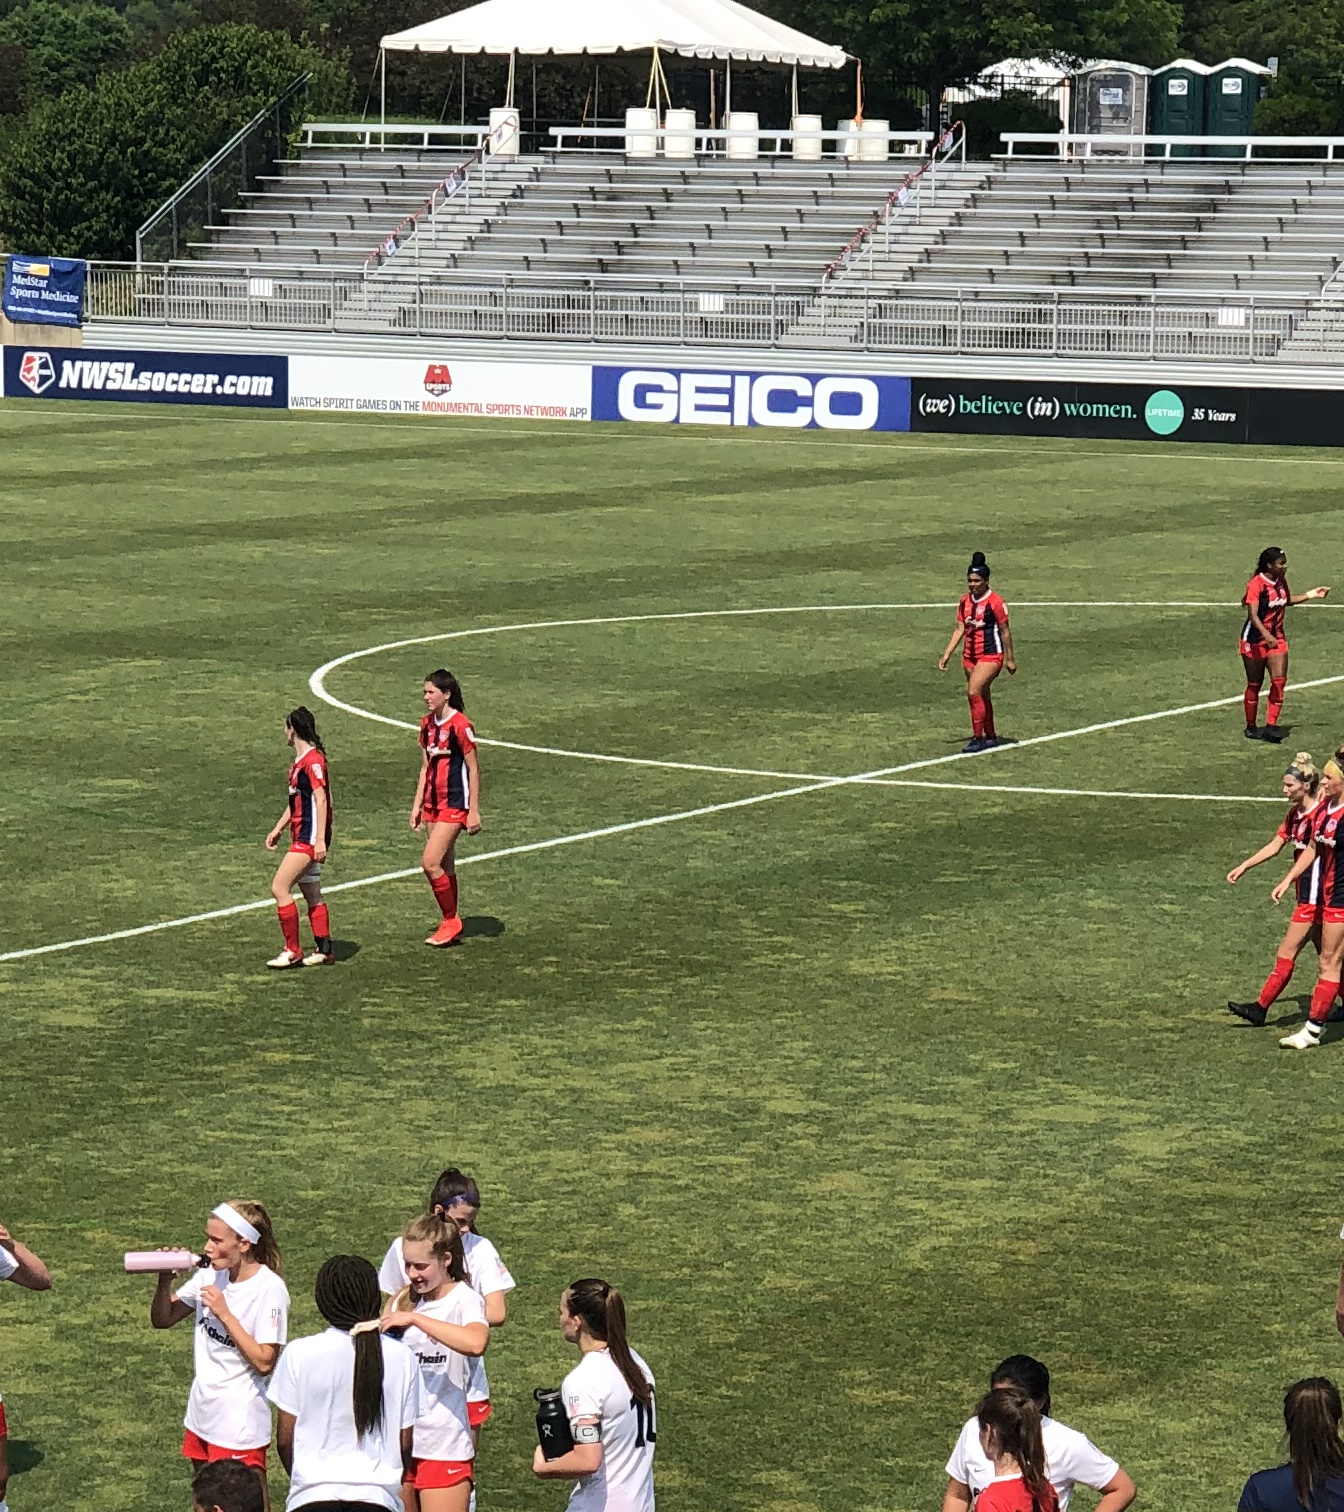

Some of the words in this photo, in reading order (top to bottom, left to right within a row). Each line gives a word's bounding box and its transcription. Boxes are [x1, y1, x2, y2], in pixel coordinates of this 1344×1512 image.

[12, 275, 48, 288] MedStar
[10, 286, 39, 299] Sports
[41, 290, 79, 303] Medicine
[59, 360, 273, 396] NWSLsoccer.com
[291, 396, 321, 408] WATCH
[323, 398, 354, 409] SPIRIT
[356, 399, 387, 411] GAMES
[389, 400, 402, 411] ON
[404, 401, 420, 412] THE
[422, 401, 484, 414] MONUMENTAL
[486, 404, 521, 415] SPORTS
[523, 405, 567, 417] NETWORK
[569, 407, 587, 418] APP
[617, 370, 879, 430] GEICO
[918, 393, 955, 416] (we)
[959, 394, 1023, 416] believe
[1027, 396, 1060, 419] (in)
[1064, 402, 1137, 419] women.
[1192, 408, 1205, 420] 35
[1208, 409, 1236, 422] Years
[582, 1427, 594, 1437] C
